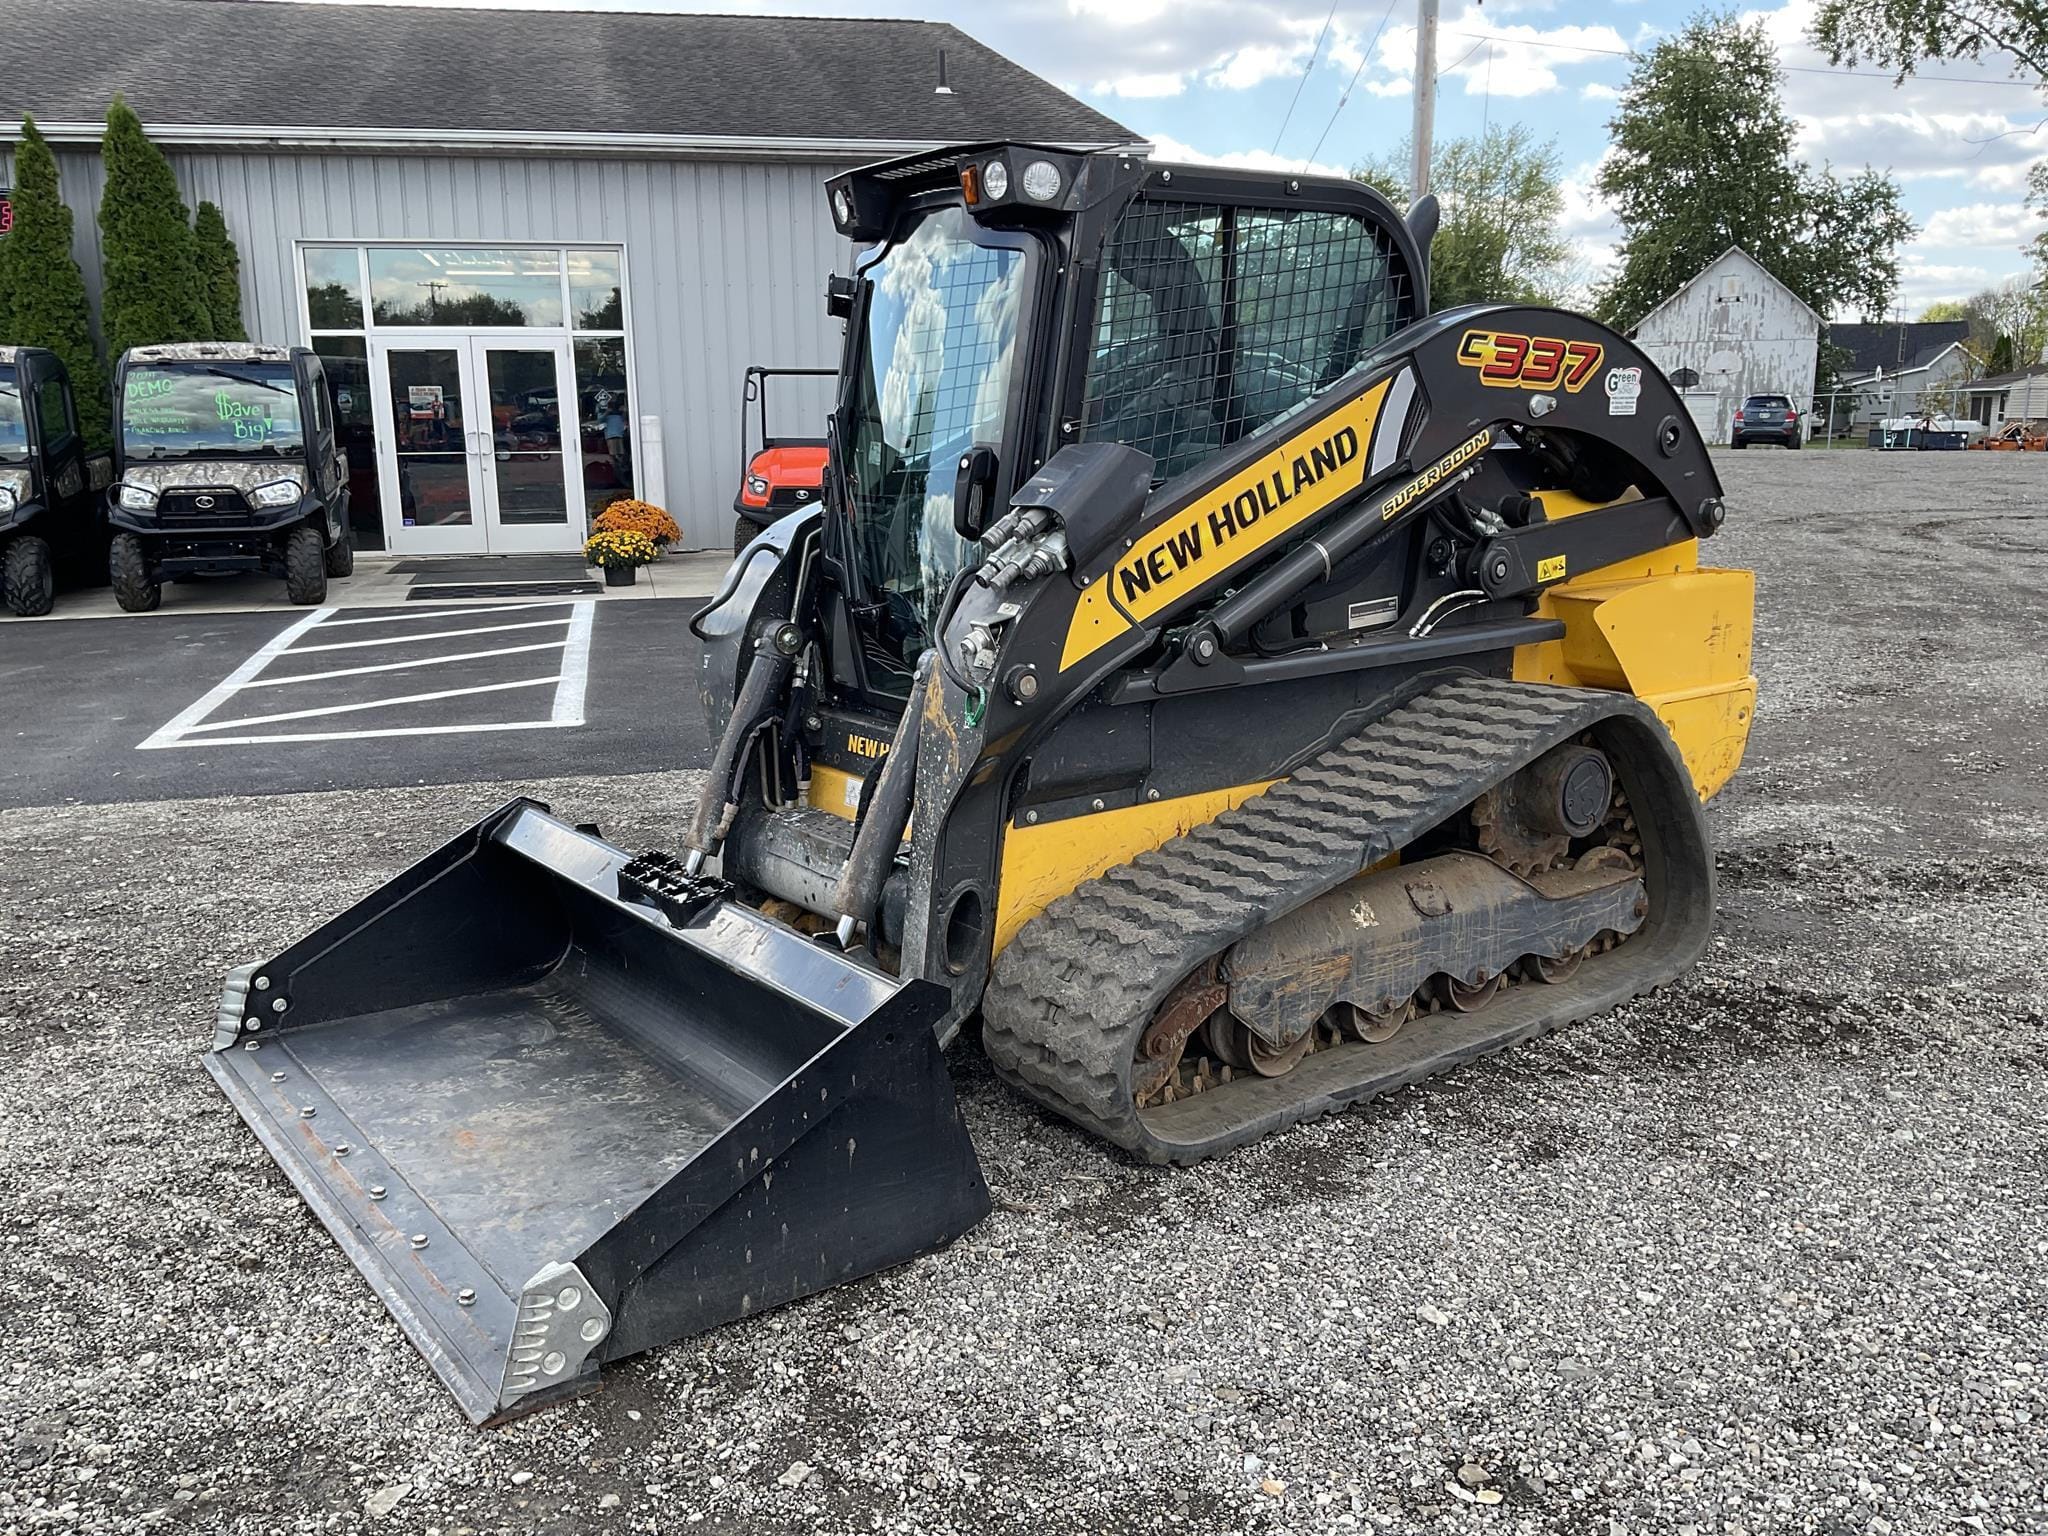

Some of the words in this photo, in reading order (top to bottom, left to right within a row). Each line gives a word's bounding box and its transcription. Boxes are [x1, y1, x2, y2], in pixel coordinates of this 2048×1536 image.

[1457, 330, 1604, 393] C337
[128, 379, 173, 398] DEMO
[1609, 373, 1637, 392] Green
[215, 390, 262, 420] $ave
[233, 417, 273, 442] Big!
[1382, 467, 1441, 520] SUPER
[1440, 429, 1490, 477] BOOM
[1119, 522, 1204, 604] NEW
[1207, 425, 1359, 548] HOLLAND
[848, 733, 879, 759] NEW
